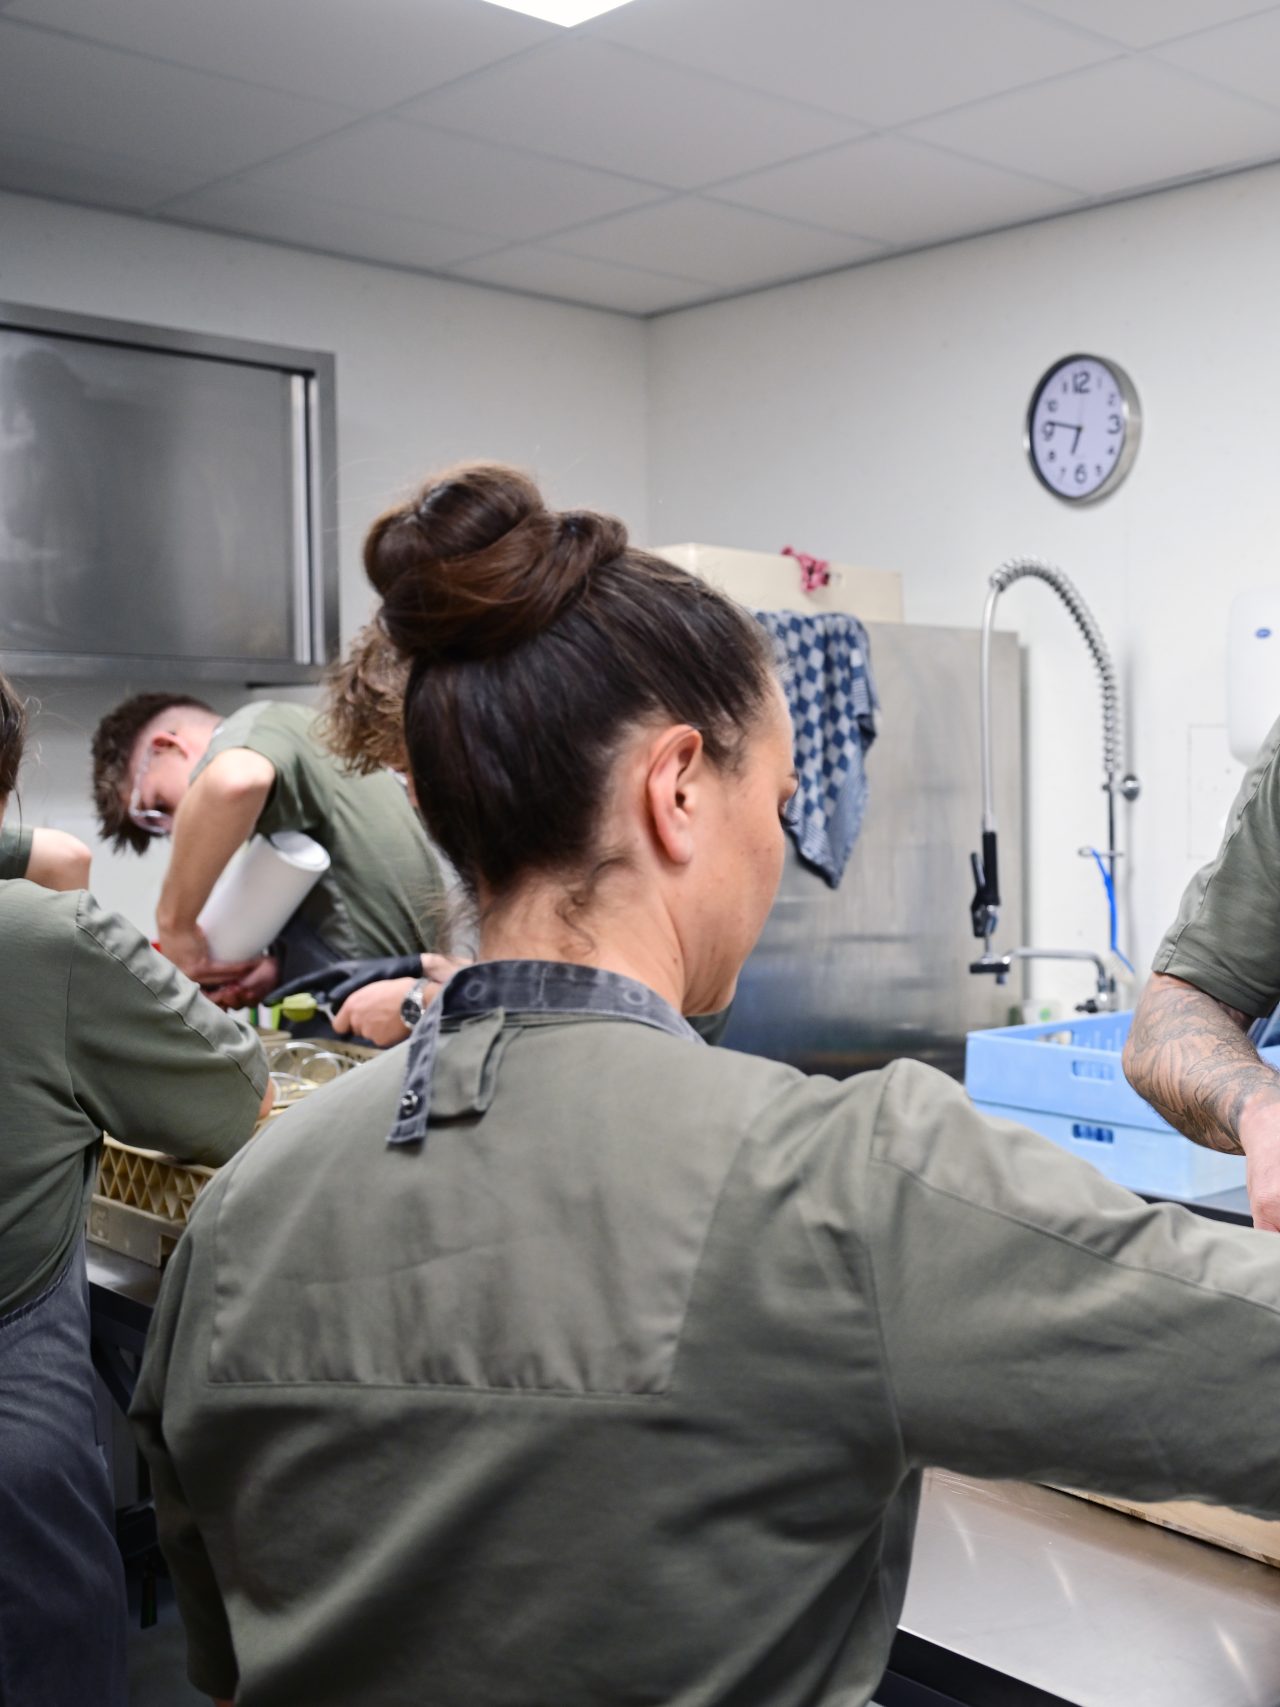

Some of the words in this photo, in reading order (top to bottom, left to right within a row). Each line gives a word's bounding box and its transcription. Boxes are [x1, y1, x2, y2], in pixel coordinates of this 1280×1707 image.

[1073, 371, 1090, 393] 12
[1042, 421, 1054, 441] 9
[1107, 414, 1120, 434] 3
[1074, 464, 1087, 484] 6
